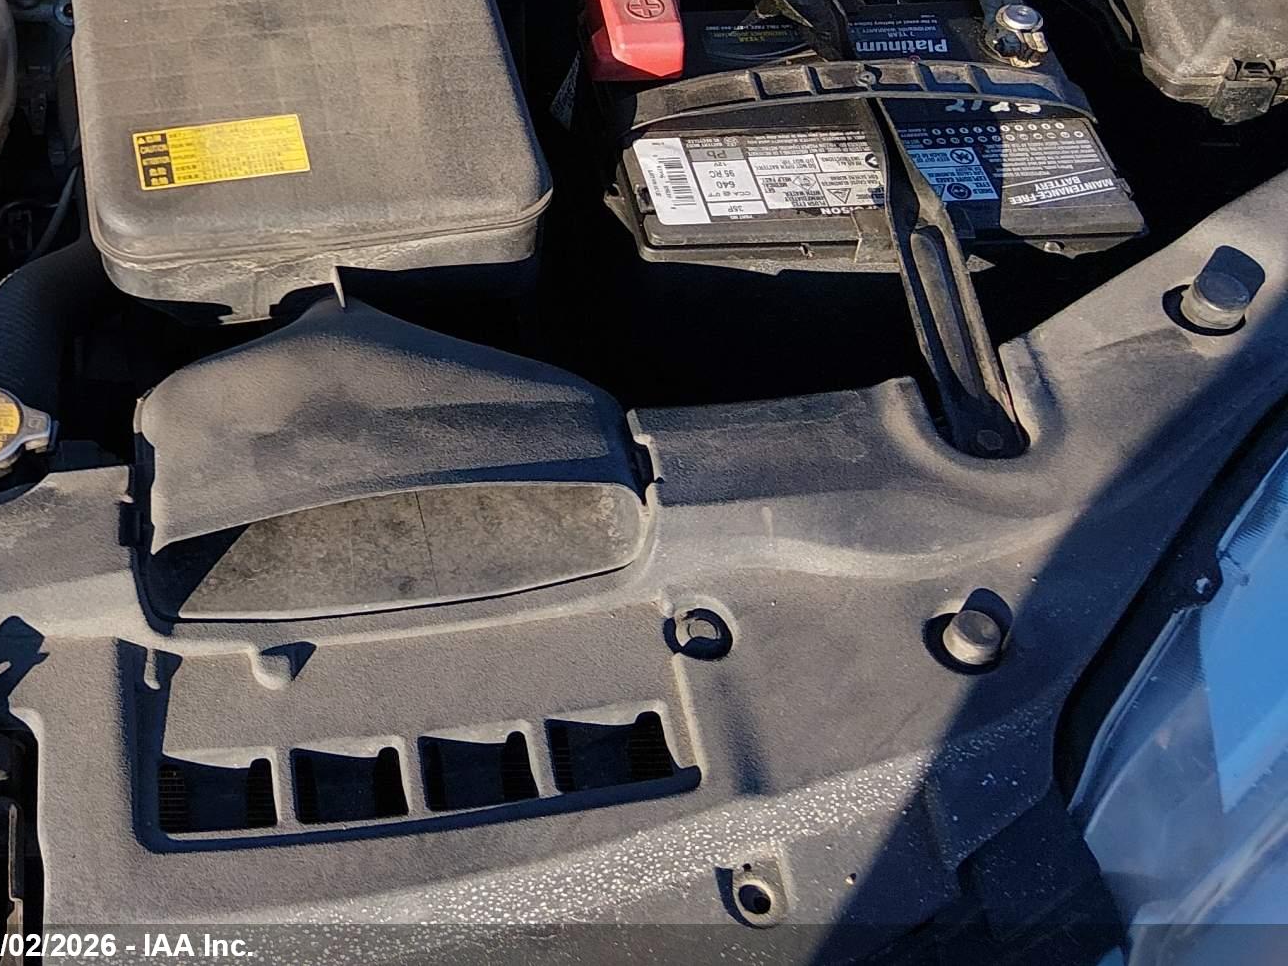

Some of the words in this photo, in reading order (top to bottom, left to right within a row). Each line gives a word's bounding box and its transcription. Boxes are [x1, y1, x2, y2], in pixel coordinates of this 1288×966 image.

[856, 39, 948, 53] Platinum
[706, 150, 728, 159] Pb
[709, 170, 722, 178] RC
[1034, 175, 1081, 192] BATTERY
[1007, 178, 1114, 205] MAINTENANCE-FREE
